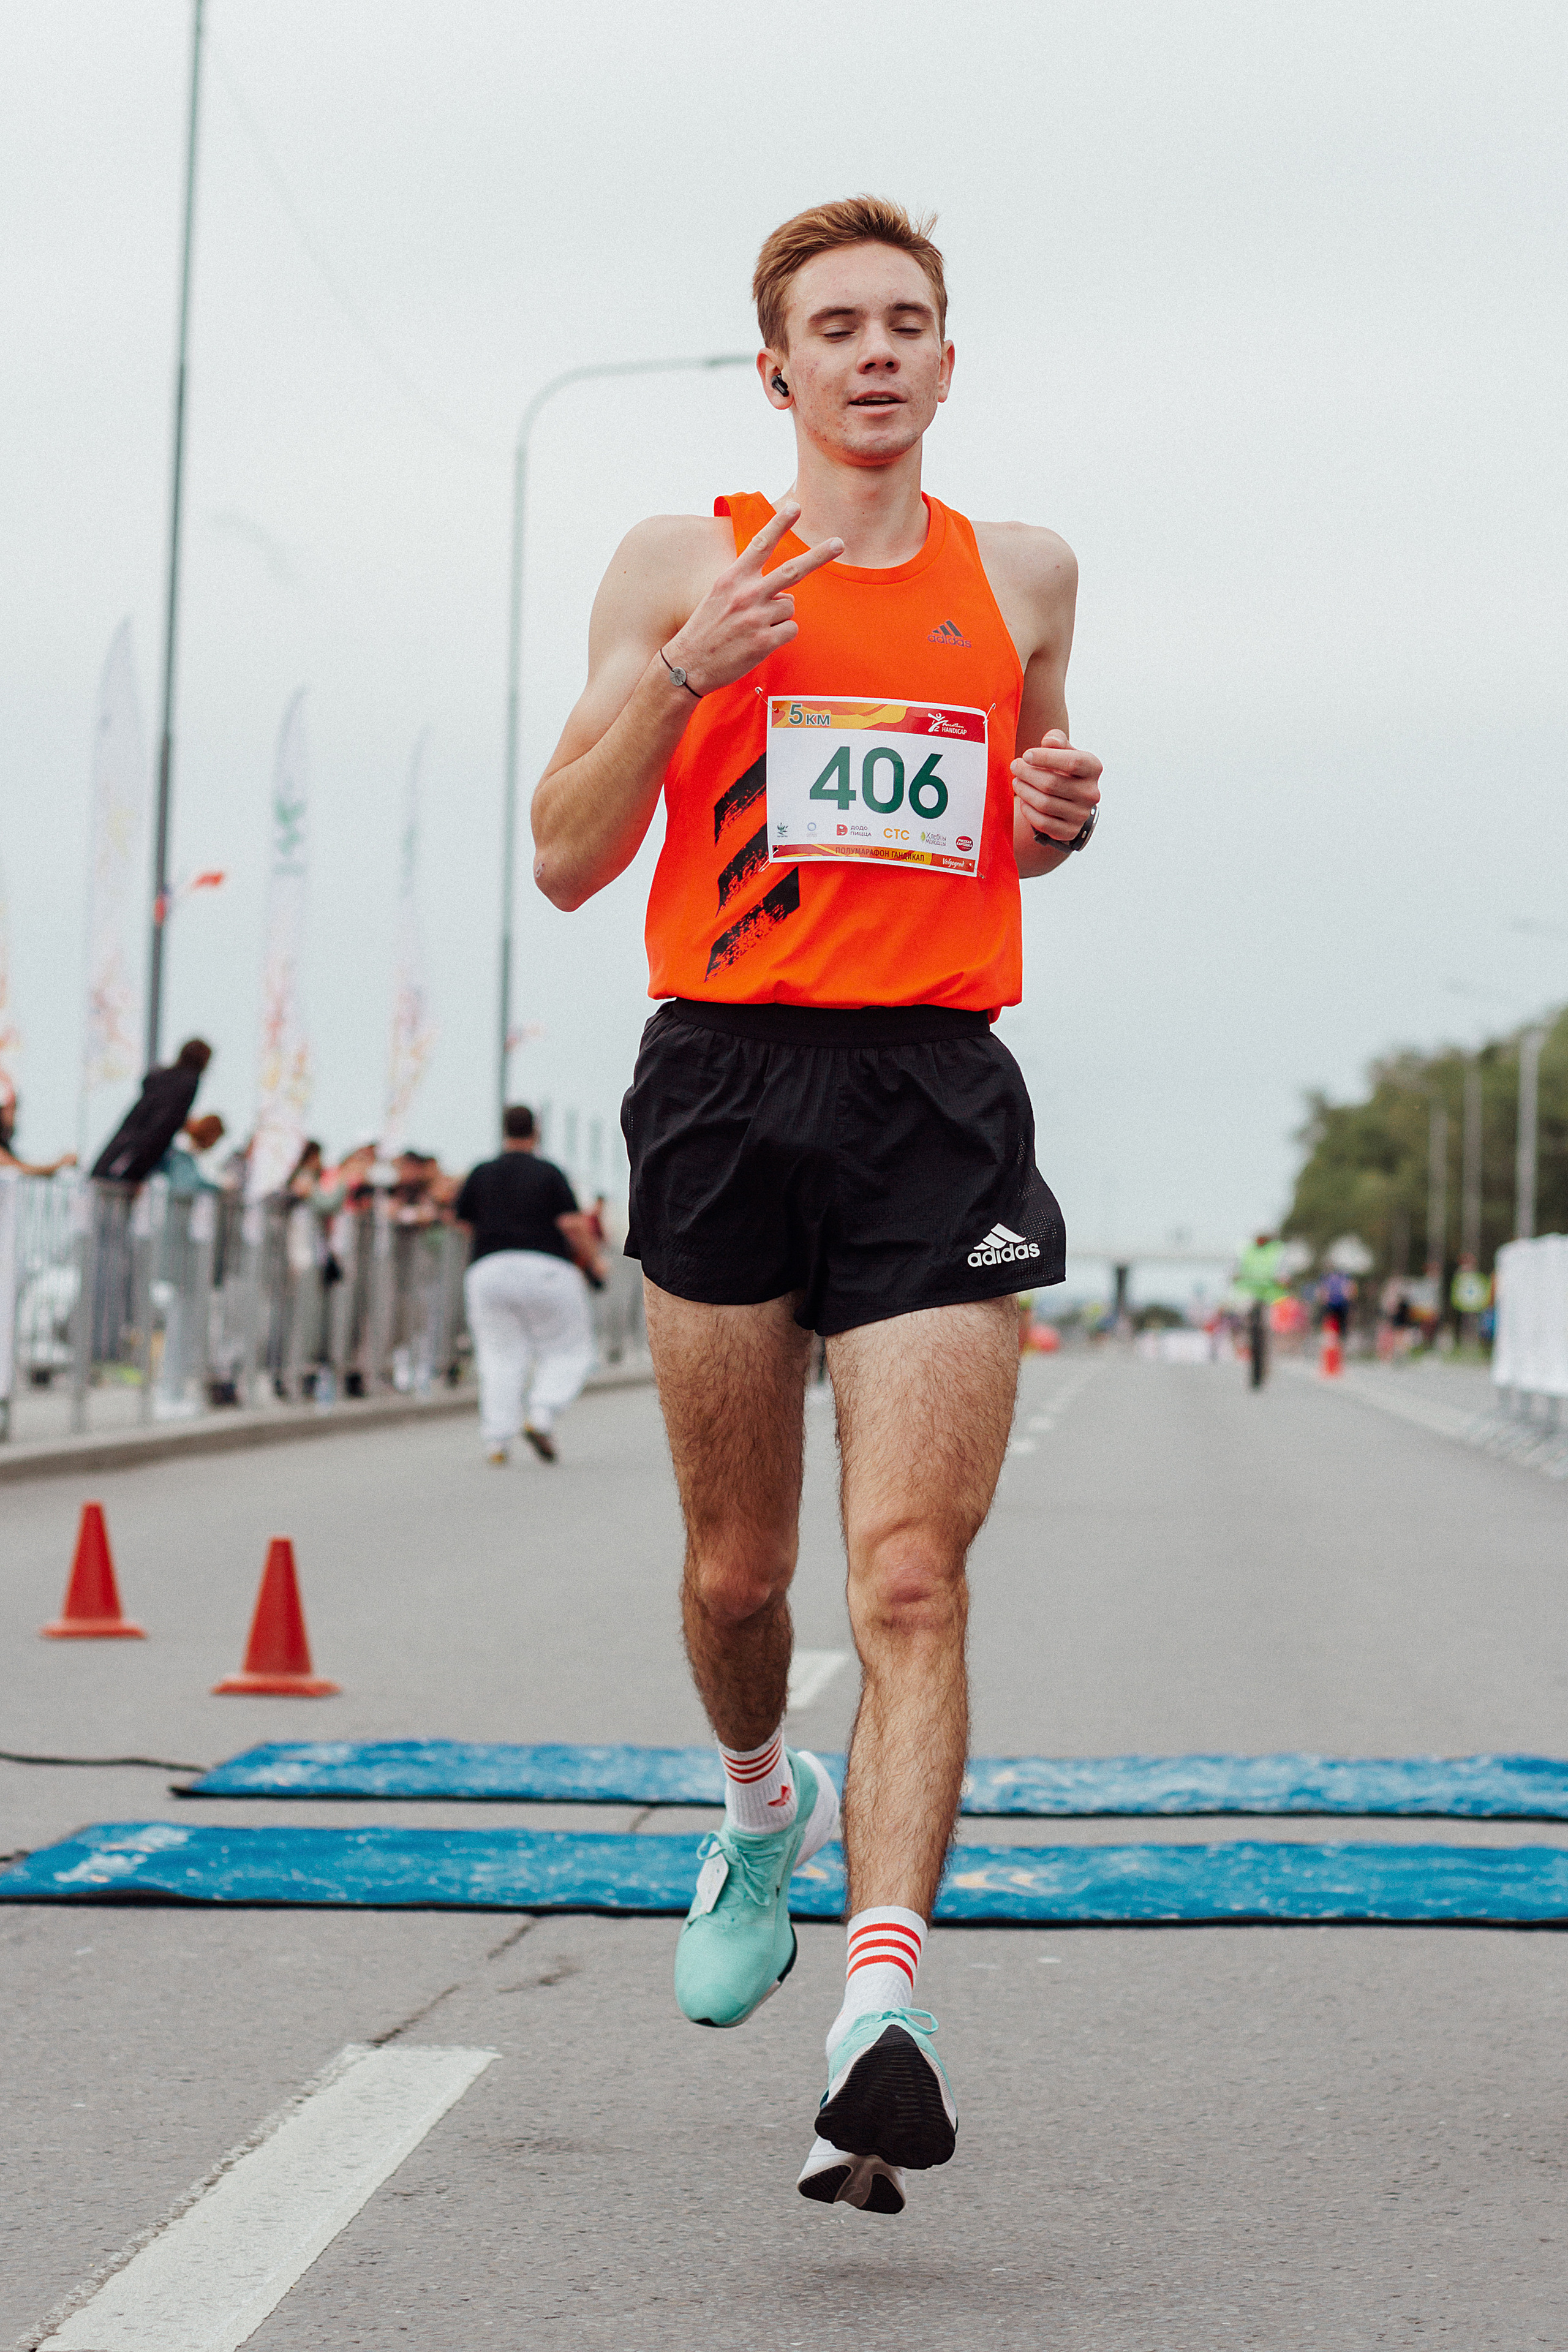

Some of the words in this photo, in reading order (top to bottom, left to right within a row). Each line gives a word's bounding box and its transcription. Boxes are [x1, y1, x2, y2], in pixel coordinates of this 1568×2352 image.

[927, 635, 971, 648] adidas
[789, 704, 804, 725] 5
[941, 726, 967, 735] HANDICAP
[809, 746, 949, 820] 406
[835, 846, 889, 858] ПОЛУМАРАФОН
[891, 850, 925, 862] ГАНДИКАП
[967, 1242, 1041, 1268] adidas
